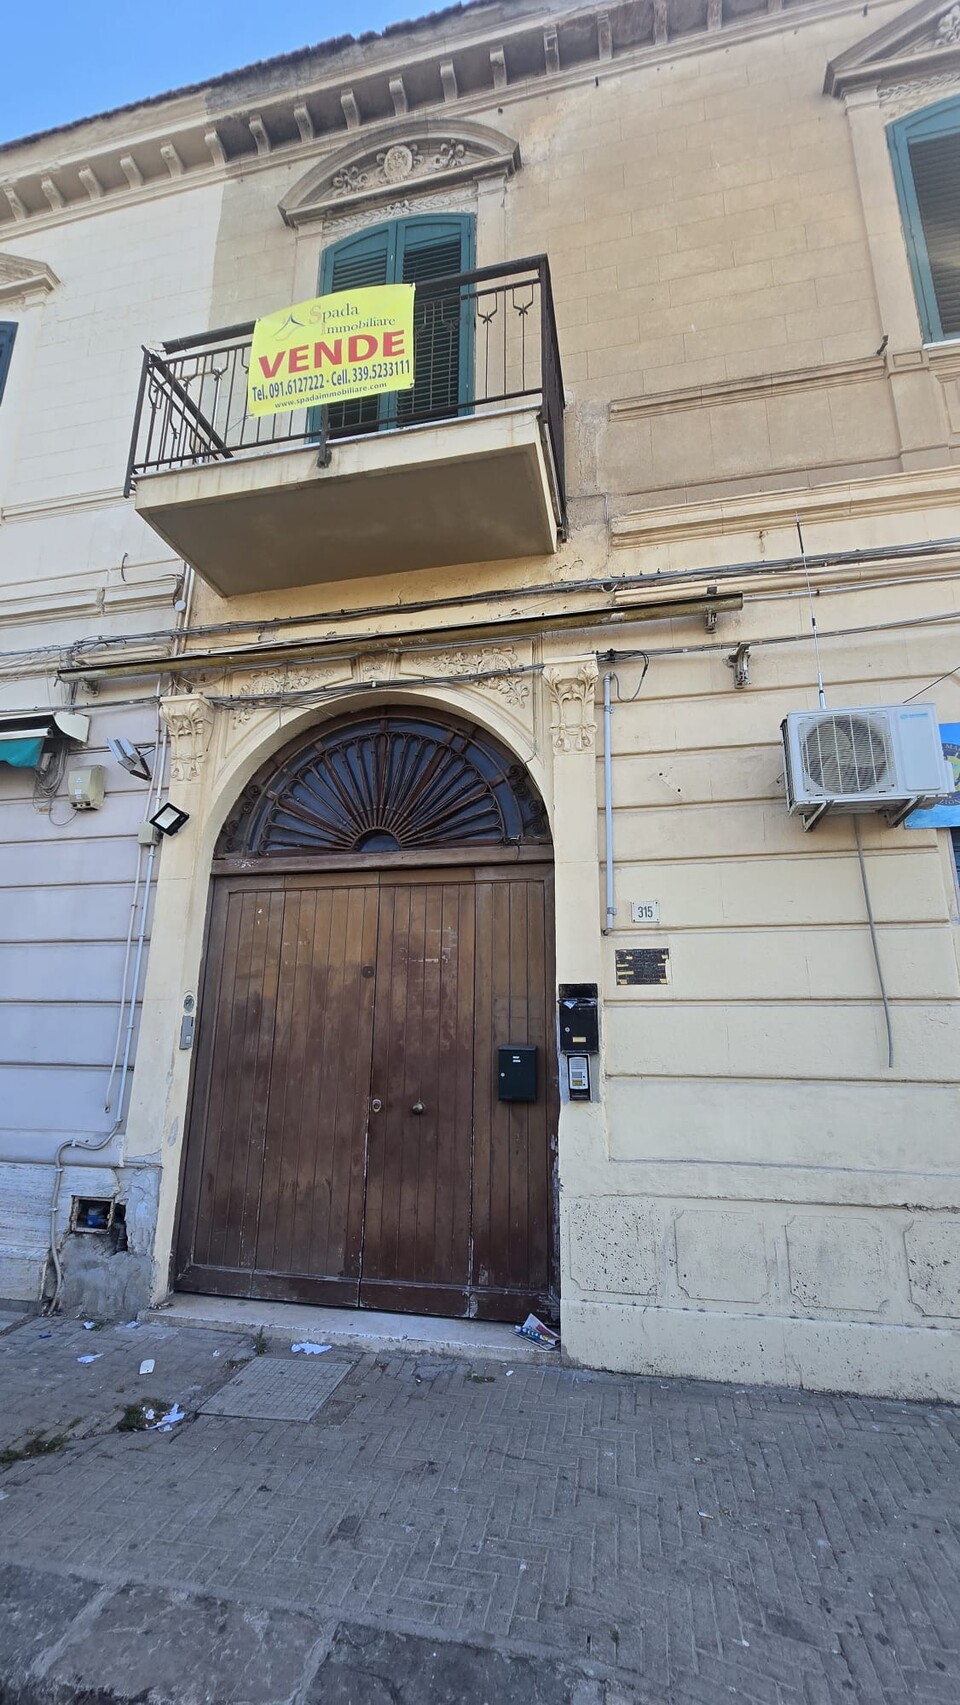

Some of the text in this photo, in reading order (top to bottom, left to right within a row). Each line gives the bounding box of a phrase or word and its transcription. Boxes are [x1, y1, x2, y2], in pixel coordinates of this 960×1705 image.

[309, 303, 359, 326] Spada
[320, 316, 395, 335] Immobiliare
[258, 329, 405, 379] VENDE
[252, 384, 268, 402] Tel.
[269, 374, 325, 399] 091.6127222
[331, 368, 351, 387] Cell.
[352, 359, 410, 383] 339.5233111
[274, 382, 387, 409] www.spadaimmobiliare.com
[637, 905, 653, 918] 315
